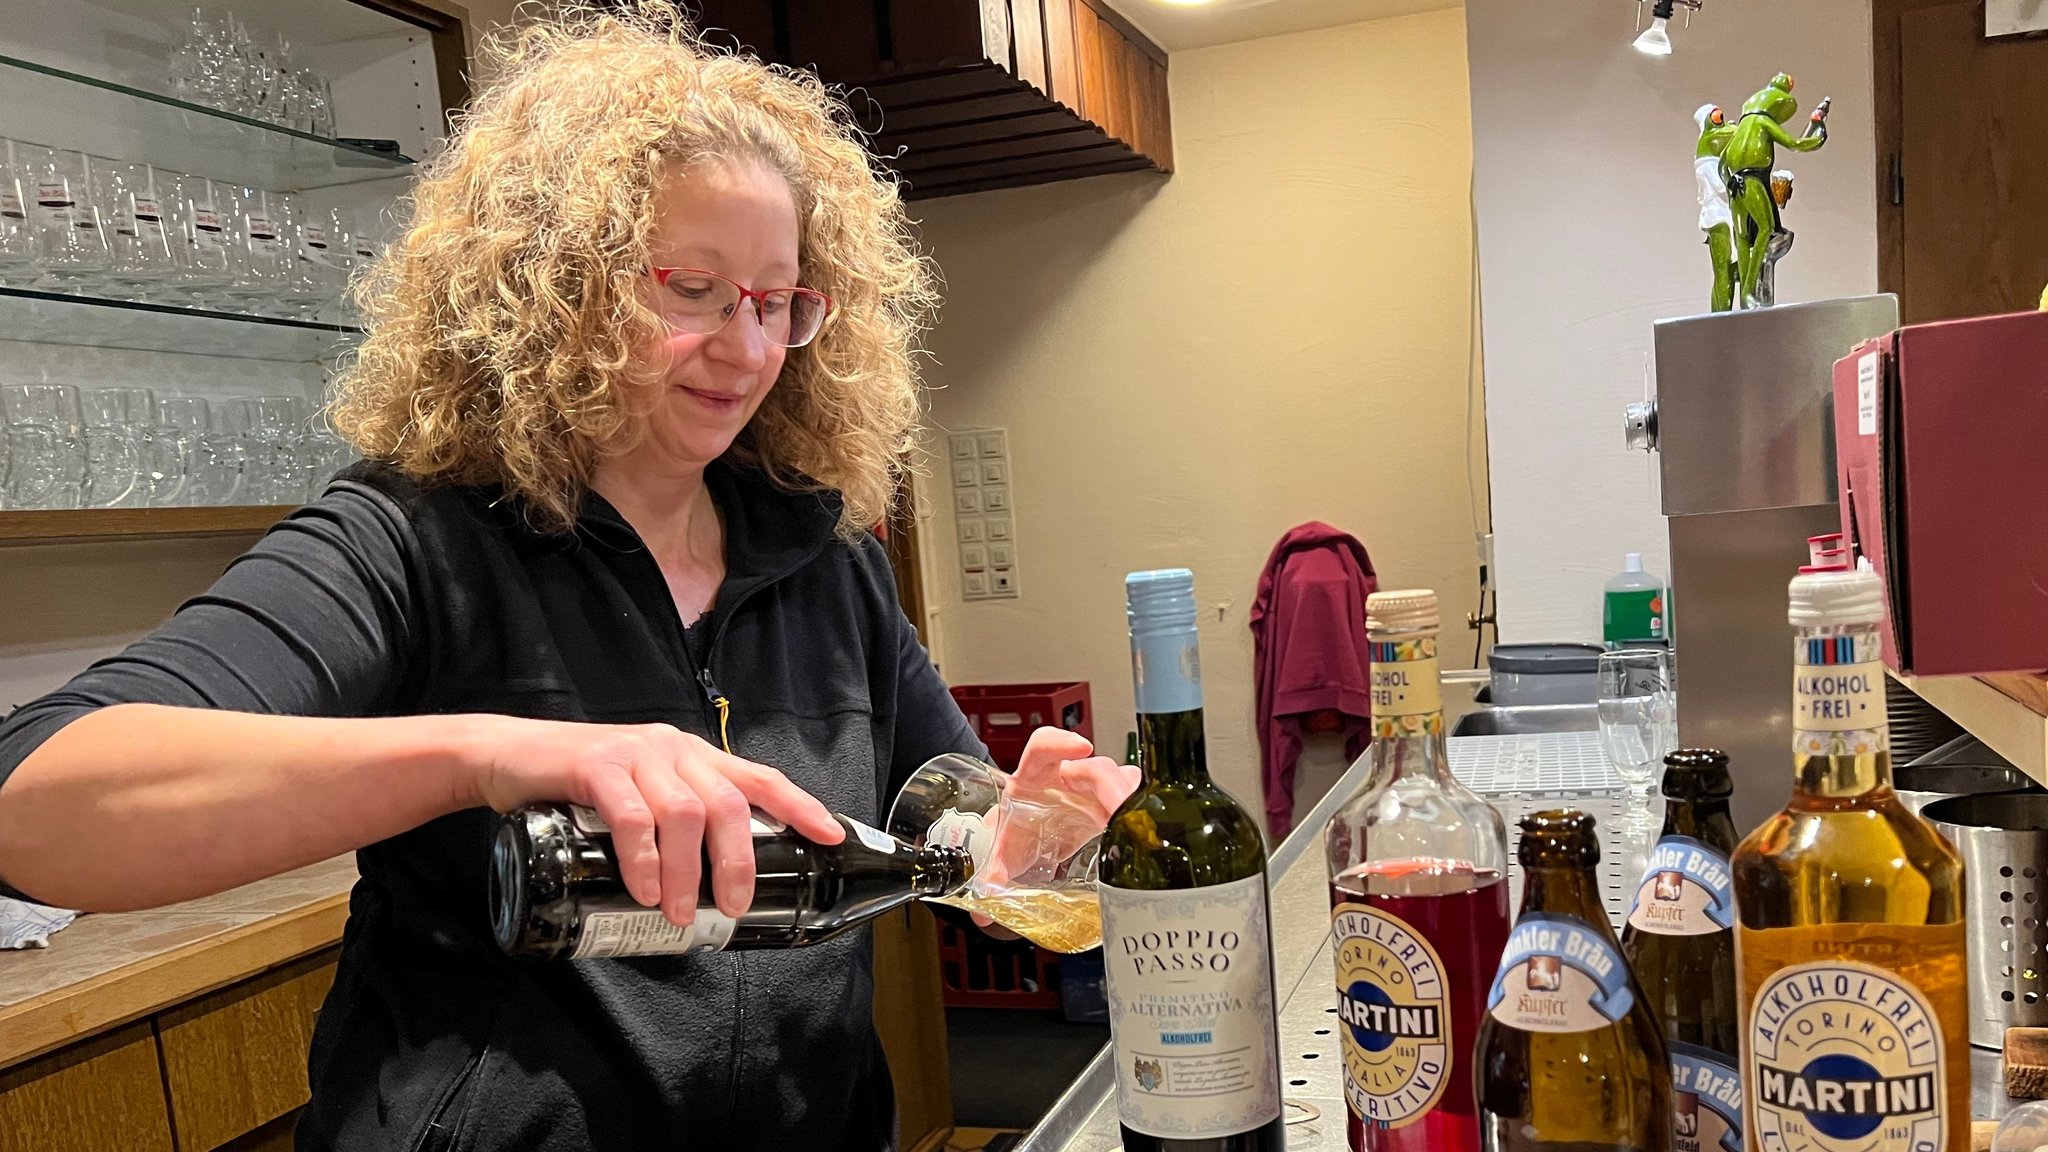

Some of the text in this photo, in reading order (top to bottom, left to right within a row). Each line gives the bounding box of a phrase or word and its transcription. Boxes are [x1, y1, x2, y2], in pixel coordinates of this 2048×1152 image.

[1371, 671, 1410, 687] OHOL
[1812, 699, 1851, 719] FREI
[1685, 850, 1730, 892] Bräu
[1122, 930, 1240, 956] DOPPIO
[1333, 914, 1437, 987] KOHOLFREI
[1563, 930, 1614, 978] Bräu
[1133, 952, 1231, 976] PASSO
[1129, 998, 1243, 1018] ALTERNATIVA
[1758, 974, 1931, 1051] ALKOHOLFREI
[1161, 1032, 1212, 1045] ALKOHOLFREI
[1783, 1012, 1896, 1054] TORINO
[1347, 1050, 1407, 1088] ITALIA
[1762, 1068, 1931, 1115] MARTINI
[1785, 1120, 1806, 1136] DAL
